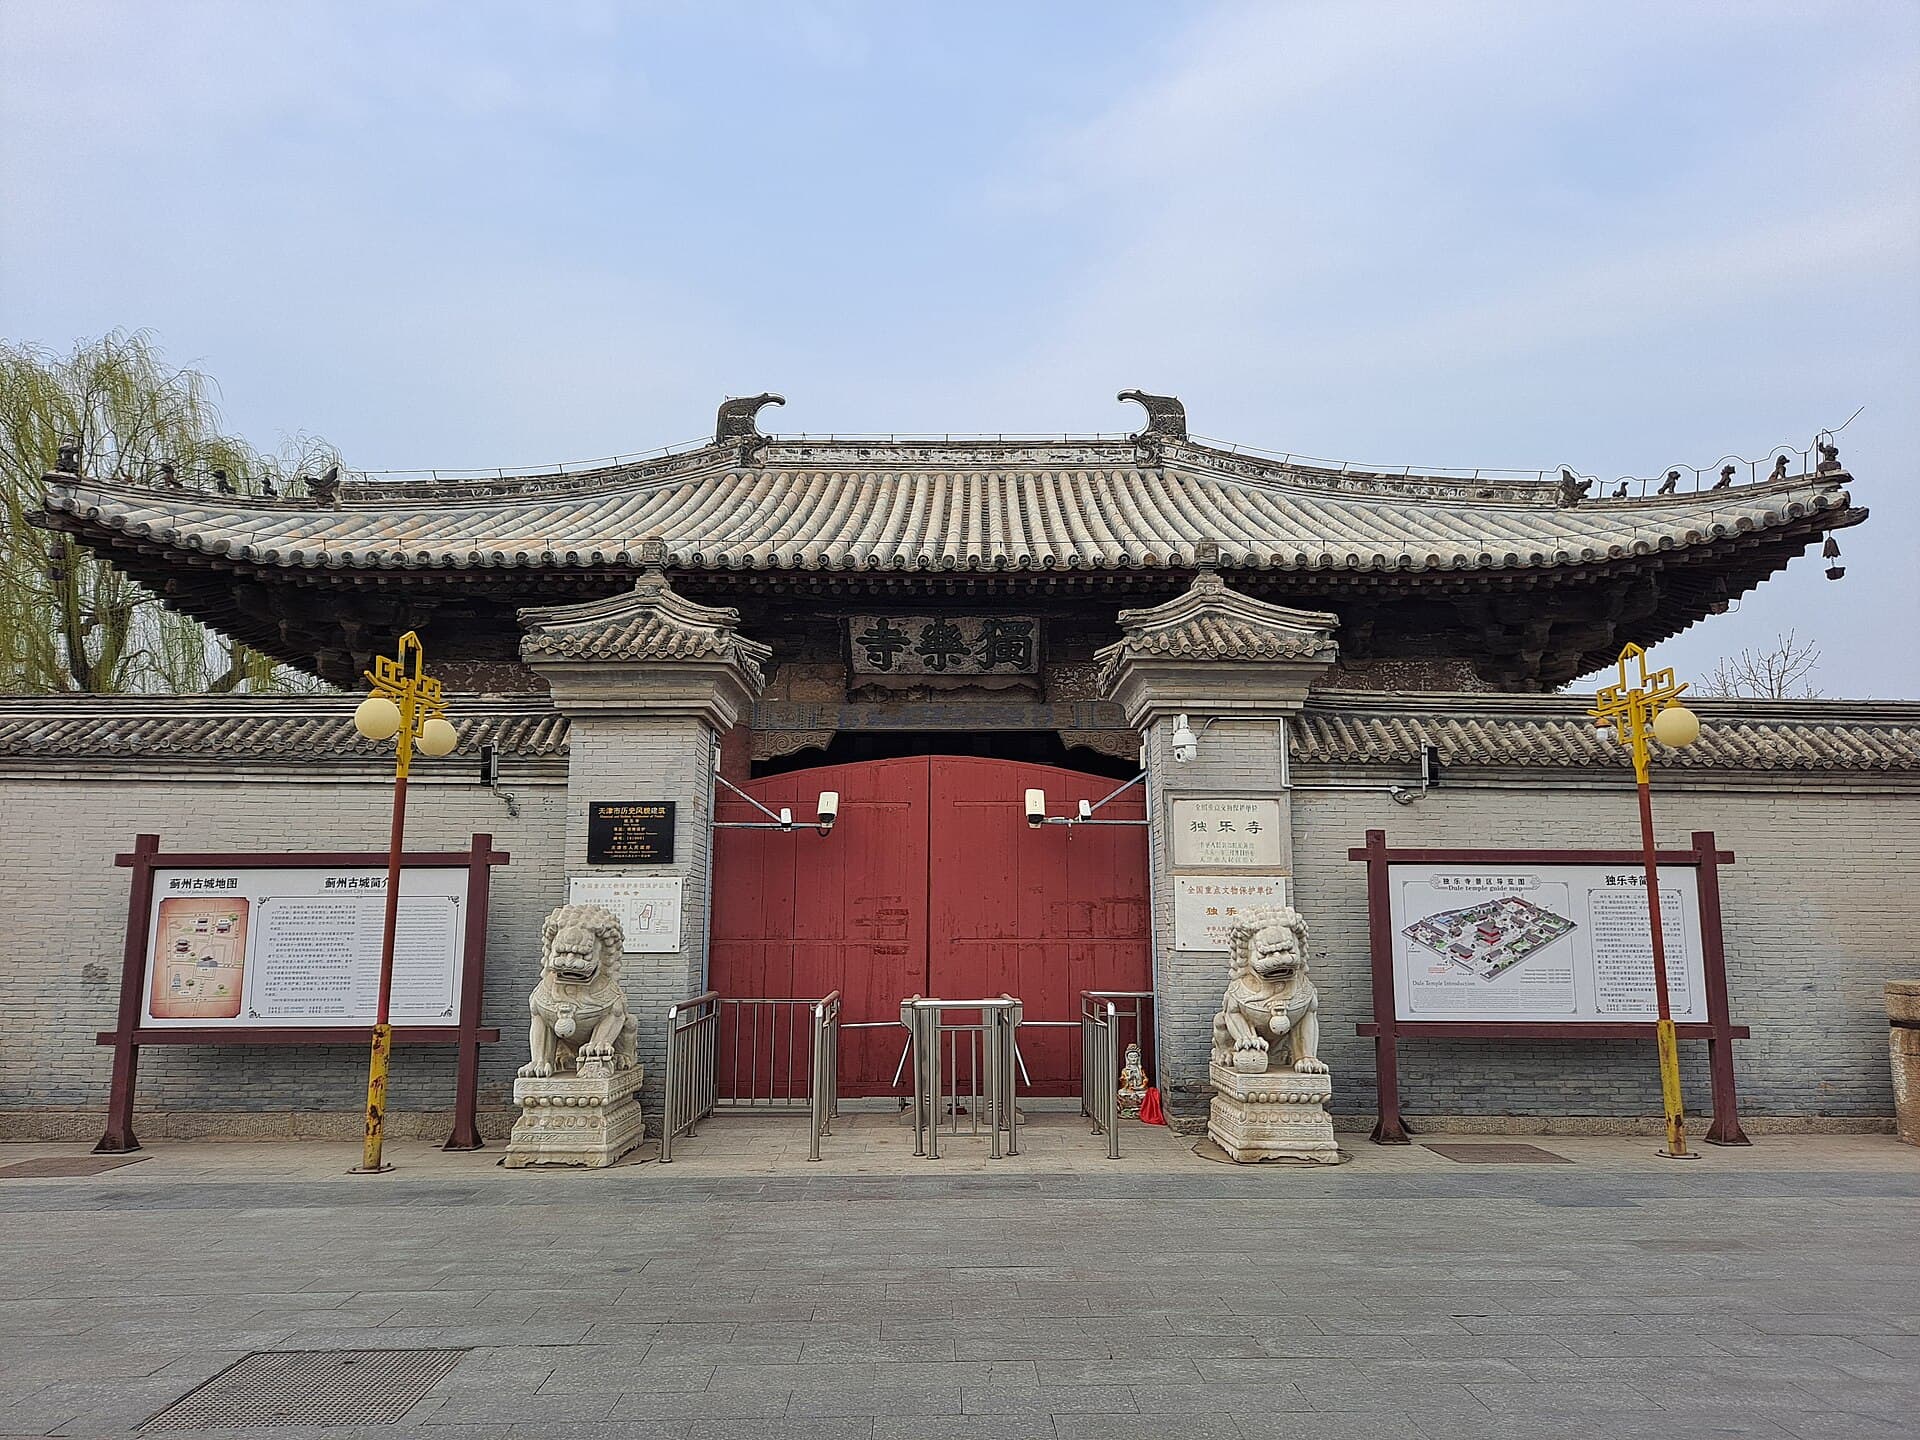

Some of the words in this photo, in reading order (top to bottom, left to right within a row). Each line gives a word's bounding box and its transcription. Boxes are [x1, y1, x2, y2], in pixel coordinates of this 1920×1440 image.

[598, 807, 667, 815] 天津市历史风貌建筑
[1190, 820, 1263, 834] 独乐寺
[169, 877, 238, 889] 蓟州古城地图
[1187, 886, 1274, 896] 全国重点文物保护单位
